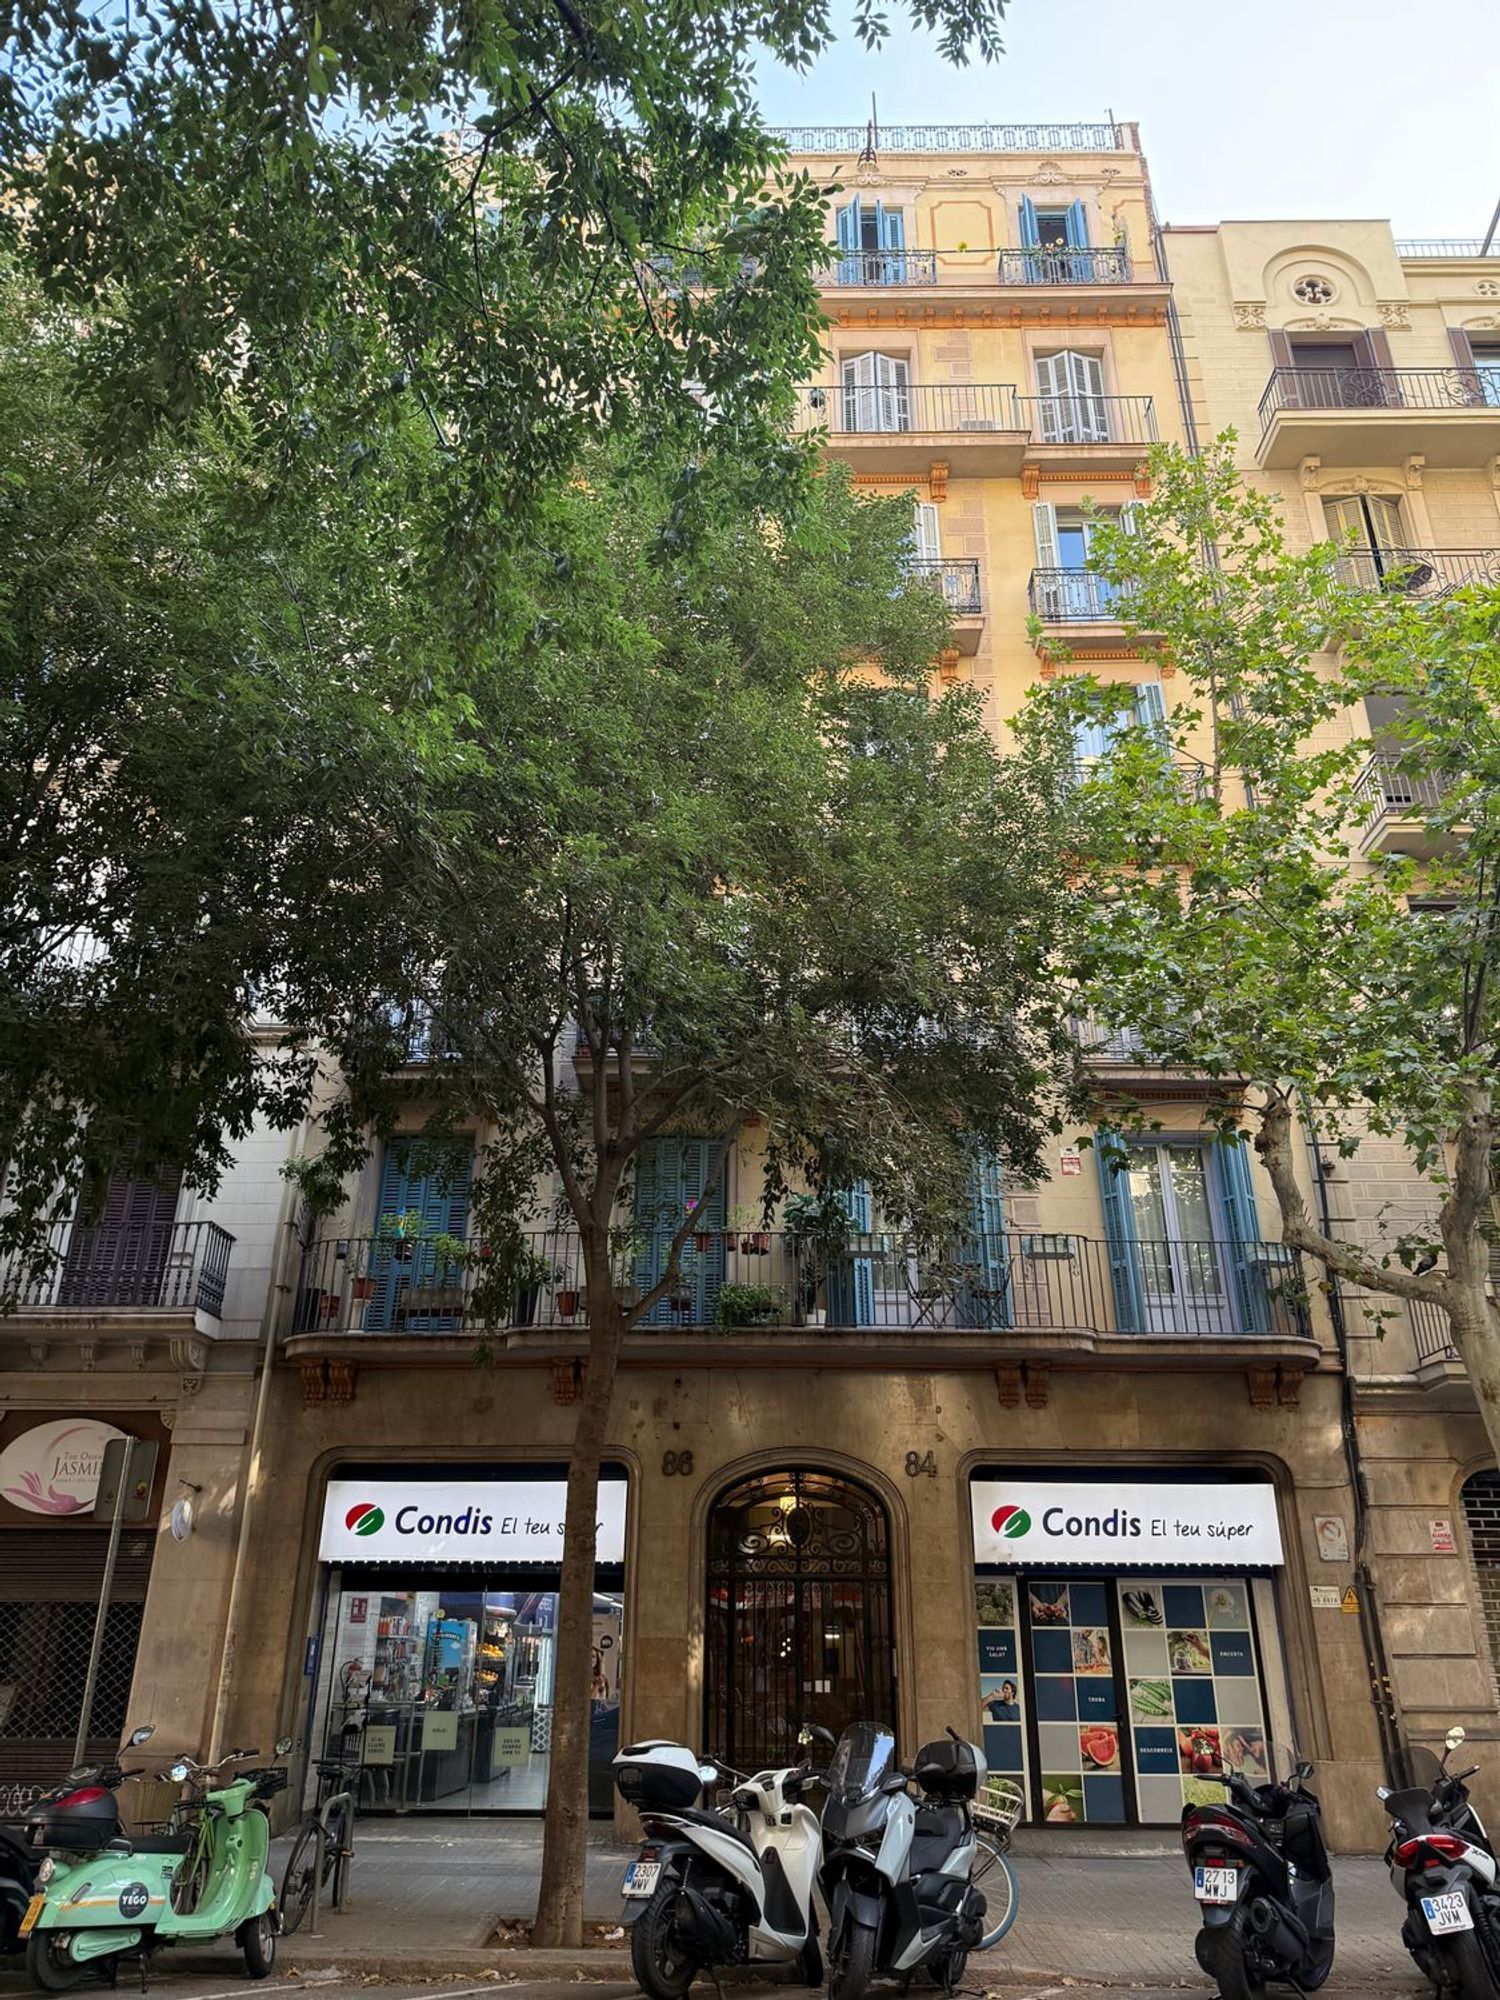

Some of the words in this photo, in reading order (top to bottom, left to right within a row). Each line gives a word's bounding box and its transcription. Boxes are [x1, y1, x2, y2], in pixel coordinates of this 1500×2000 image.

[51, 1456, 102, 1480] JASMI
[905, 1450, 938, 1478] 84
[395, 1505, 493, 1536] Condis
[501, 1517, 518, 1535] El
[524, 1517, 550, 1535] teu
[1042, 1507, 1141, 1537] Condis
[1150, 1519, 1167, 1536] El
[1173, 1519, 1201, 1536] teu
[1207, 1520, 1254, 1539] súper
[634, 1865, 659, 1878] 2307
[1205, 1870, 1235, 1884] 2713
[1205, 1884, 1228, 1897] MWJ
[122, 1895, 147, 1905] YEGO
[1432, 1894, 1464, 1912] 3423
[1438, 1909, 1462, 1926] JVM
